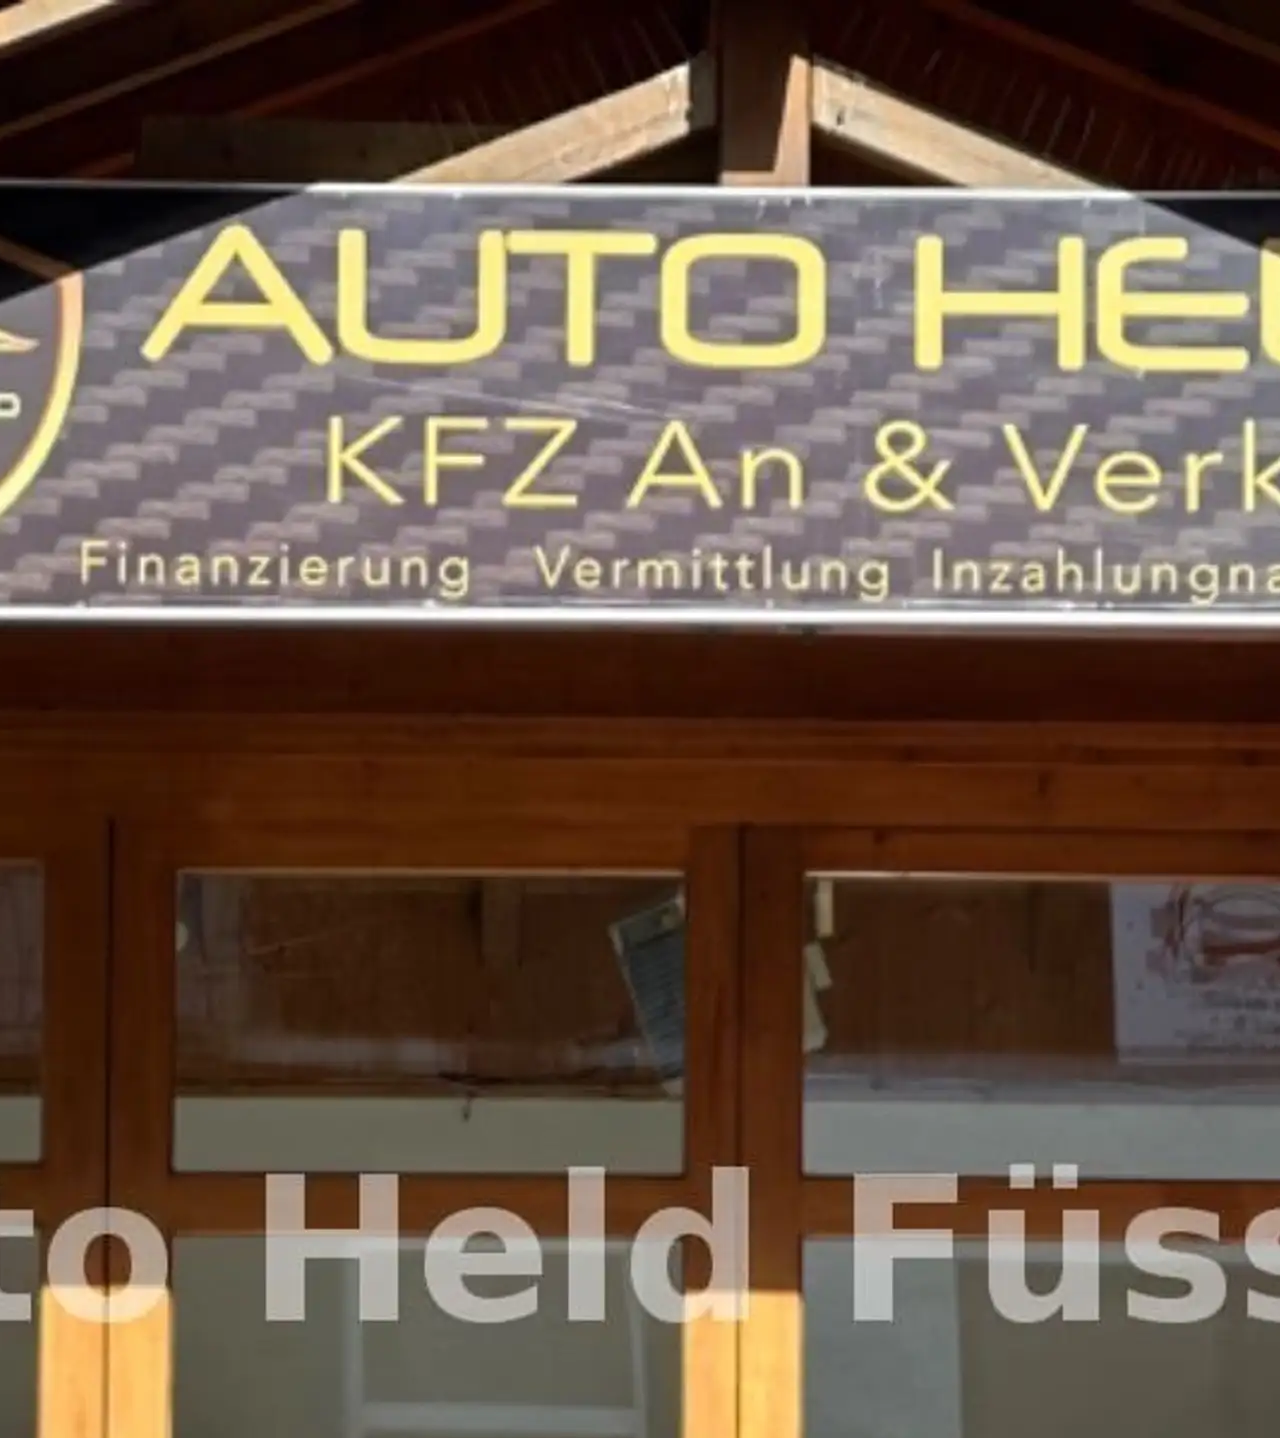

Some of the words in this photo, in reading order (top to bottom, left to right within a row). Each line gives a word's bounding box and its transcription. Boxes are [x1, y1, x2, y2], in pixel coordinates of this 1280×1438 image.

[140, 224, 828, 368] AUTO
[326, 415, 579, 507] KFZ
[625, 419, 805, 509] An
[863, 419, 954, 512] &
[79, 539, 471, 597] Finanzierung
[532, 543, 892, 600] Vermittlung
